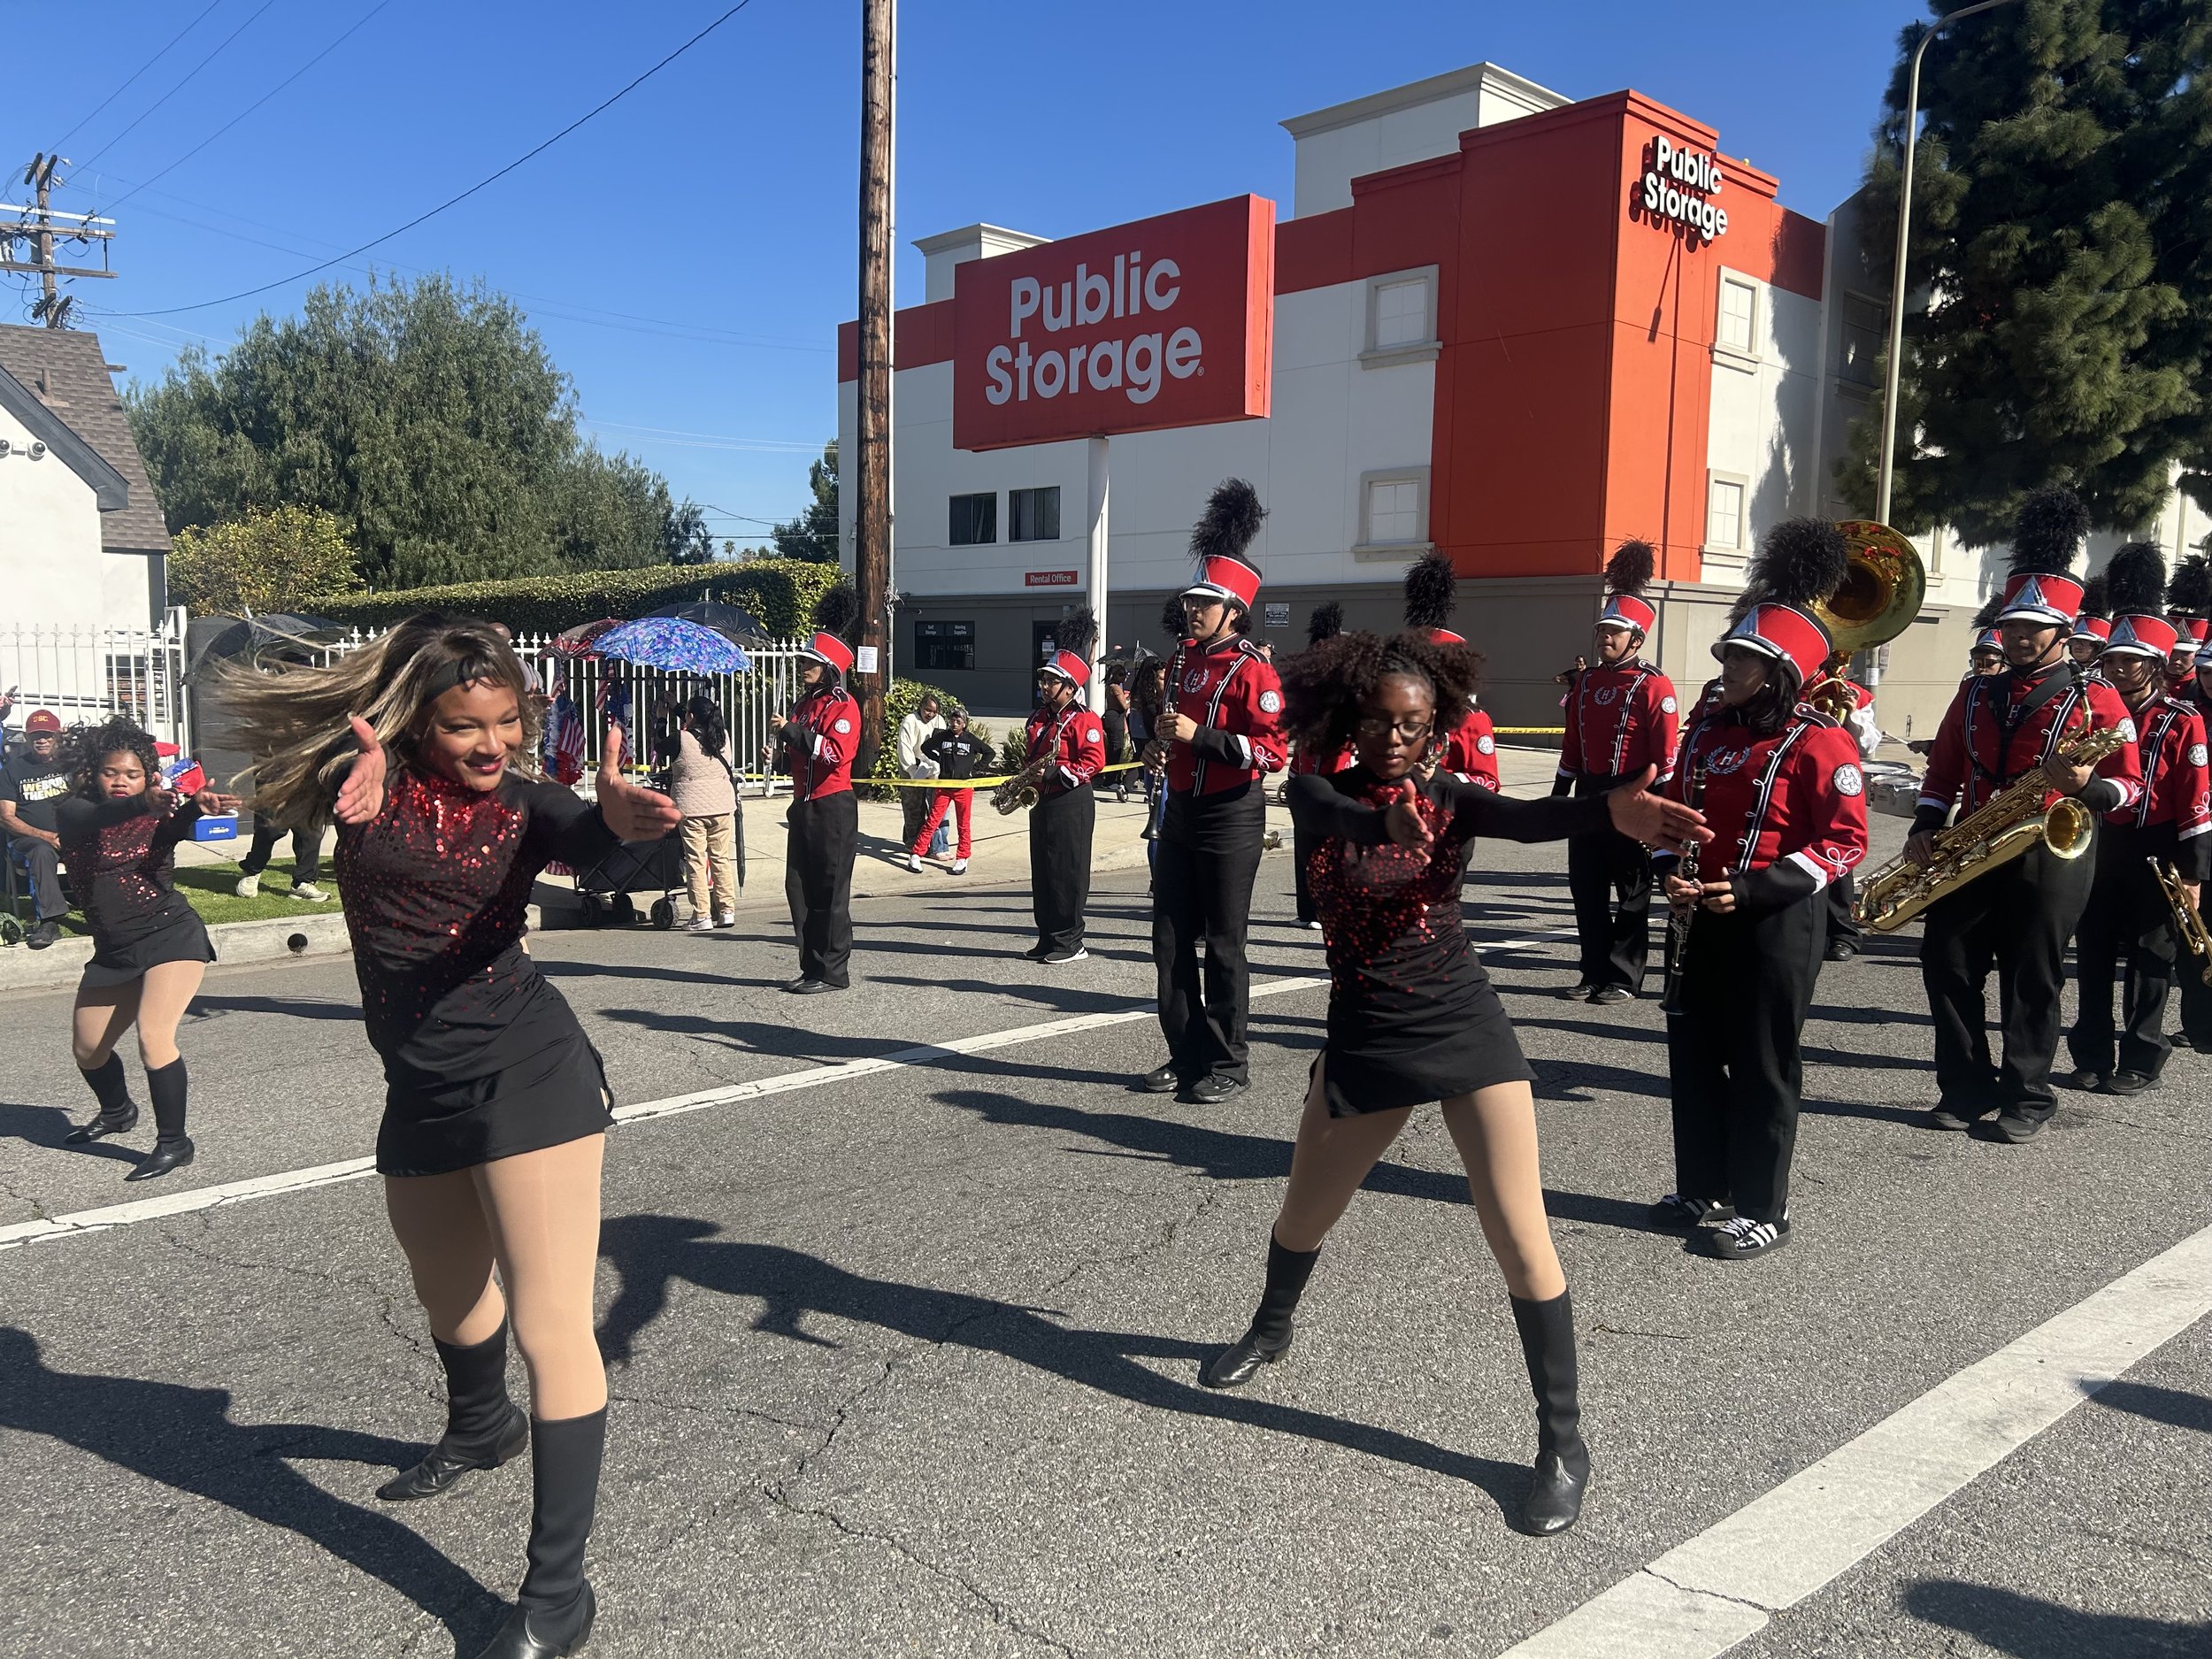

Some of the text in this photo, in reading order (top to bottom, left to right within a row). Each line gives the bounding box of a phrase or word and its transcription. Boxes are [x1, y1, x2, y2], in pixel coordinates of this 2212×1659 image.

[1655, 134, 1723, 195] Public
[1643, 171, 1728, 241] Storage
[1010, 250, 1181, 339] Public
[984, 326, 1203, 406] Storage
[1029, 572, 1071, 584] Rental Office
[1719, 751, 1738, 765] H
